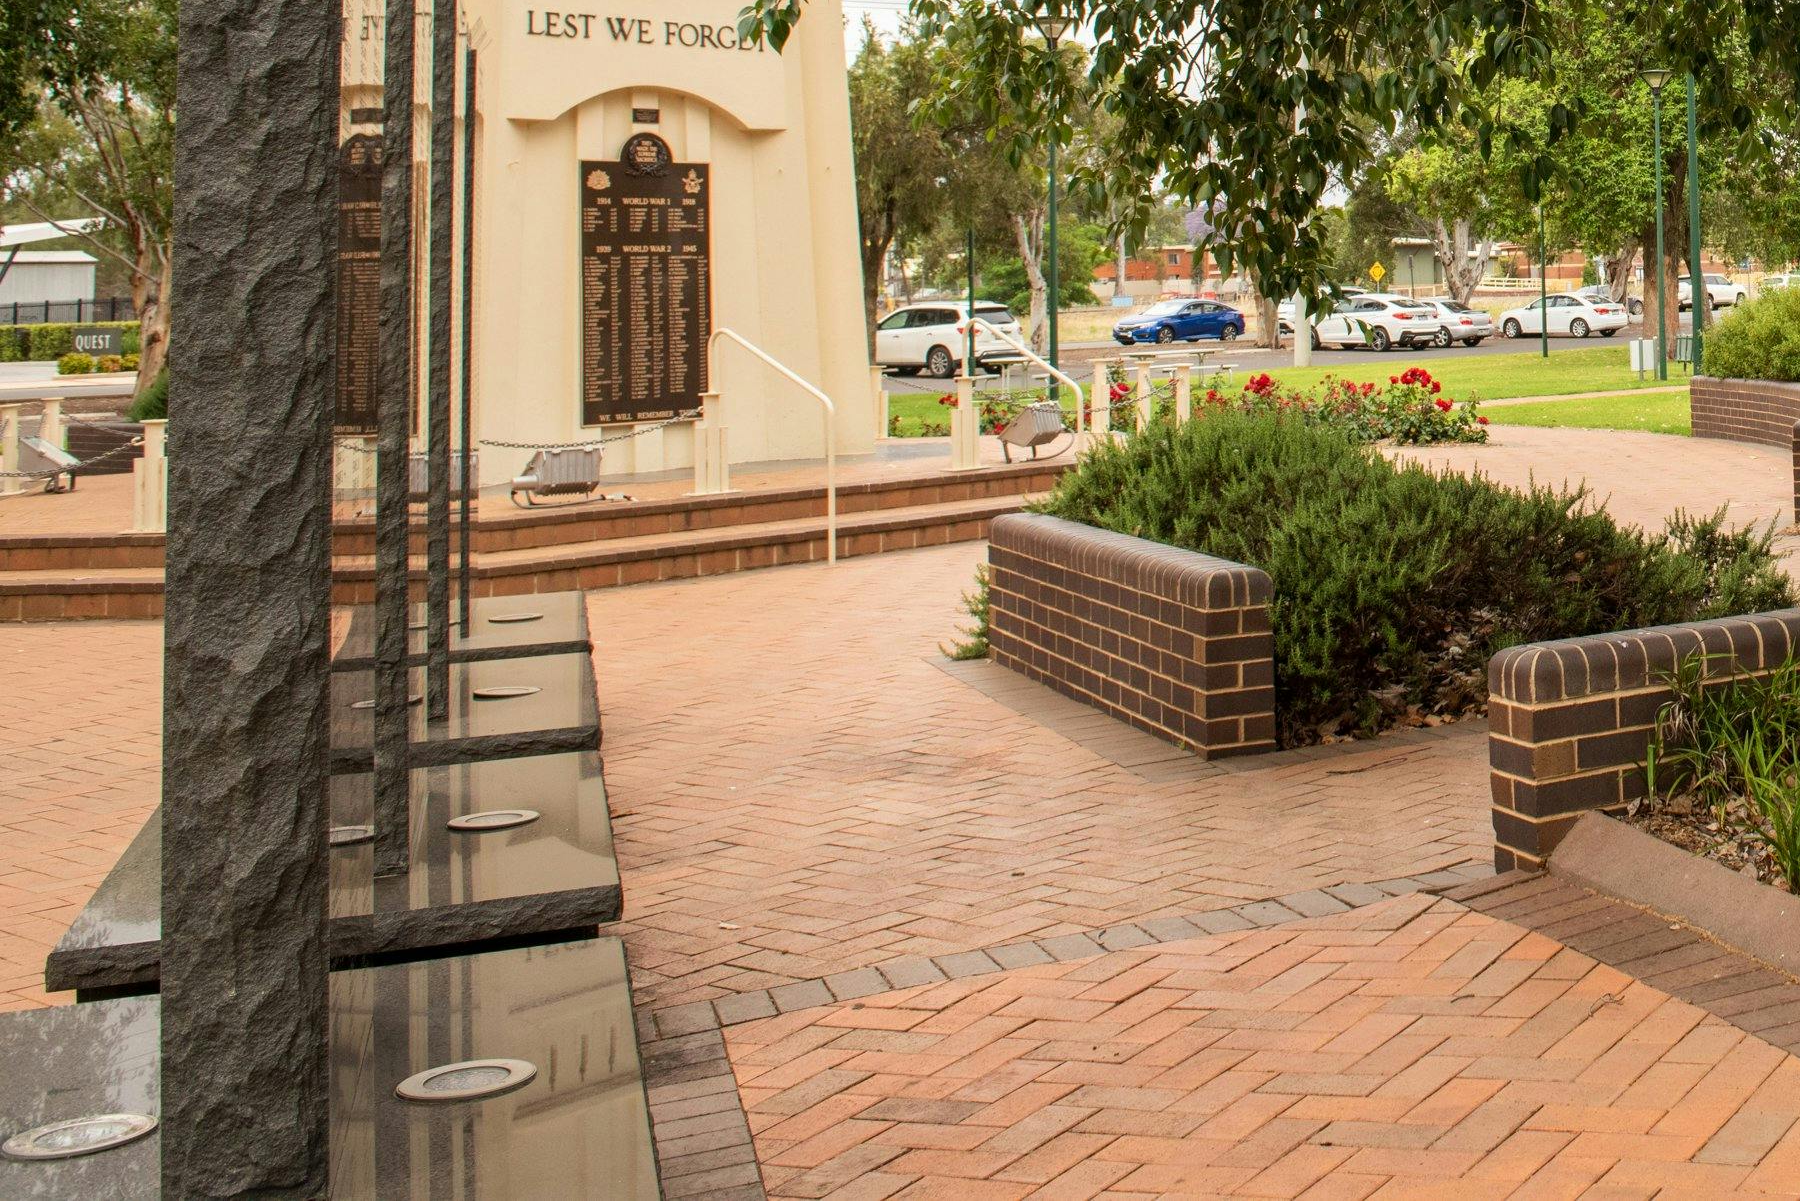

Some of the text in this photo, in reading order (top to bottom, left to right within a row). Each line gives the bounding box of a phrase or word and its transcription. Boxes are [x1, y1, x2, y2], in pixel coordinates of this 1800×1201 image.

[527, 10, 596, 39] LEST
[606, 17, 654, 45] WE
[622, 245, 649, 253] WORLD
[650, 245, 666, 253] WAR
[667, 245, 672, 253] 2
[75, 334, 111, 352] QUEST
[600, 414, 611, 422] WE
[637, 410, 674, 420] REMEMBER
